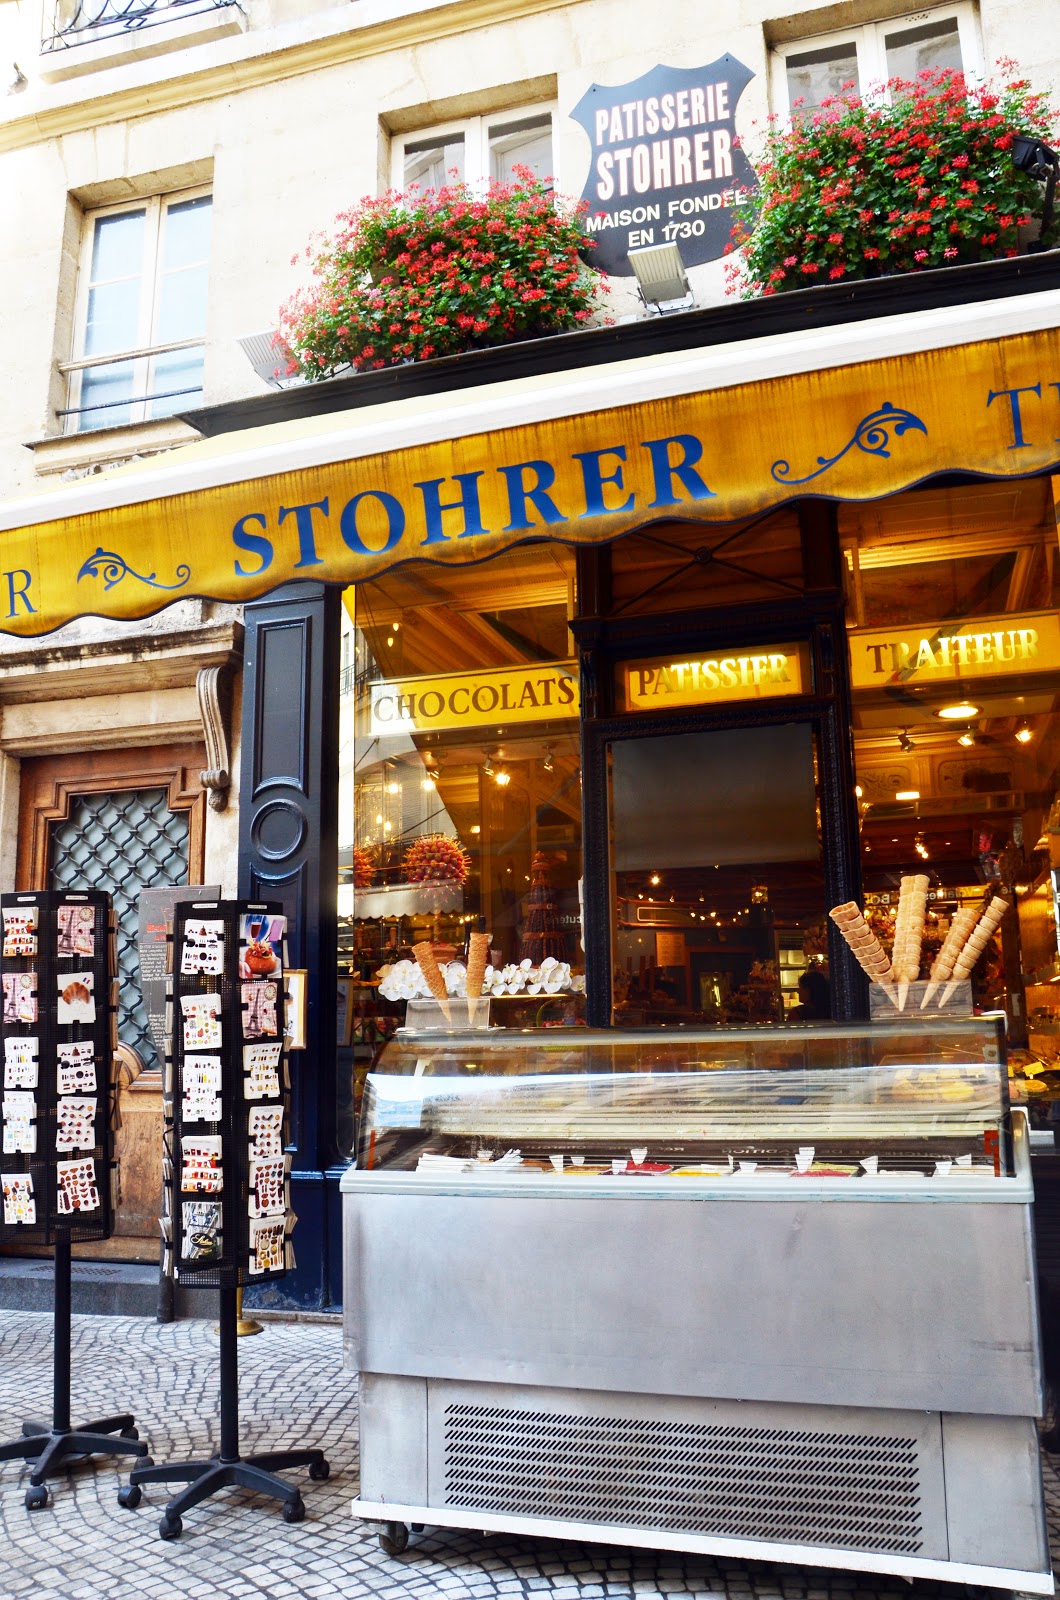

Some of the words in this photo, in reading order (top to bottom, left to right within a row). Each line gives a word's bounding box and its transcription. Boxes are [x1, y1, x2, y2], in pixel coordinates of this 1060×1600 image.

[594, 81, 731, 147] PATISSERIE
[596, 128, 734, 201] STOHRER
[586, 203, 661, 233] MAISON
[628, 227, 655, 248] EN
[661, 219, 706, 242] 1730
[230, 433, 718, 578] STOHRER
[3, 568, 38, 619] R
[866, 628, 1040, 673] TRAITEUR
[637, 653, 791, 698] PATISSIER
[373, 676, 576, 721] CHOCOLATS
